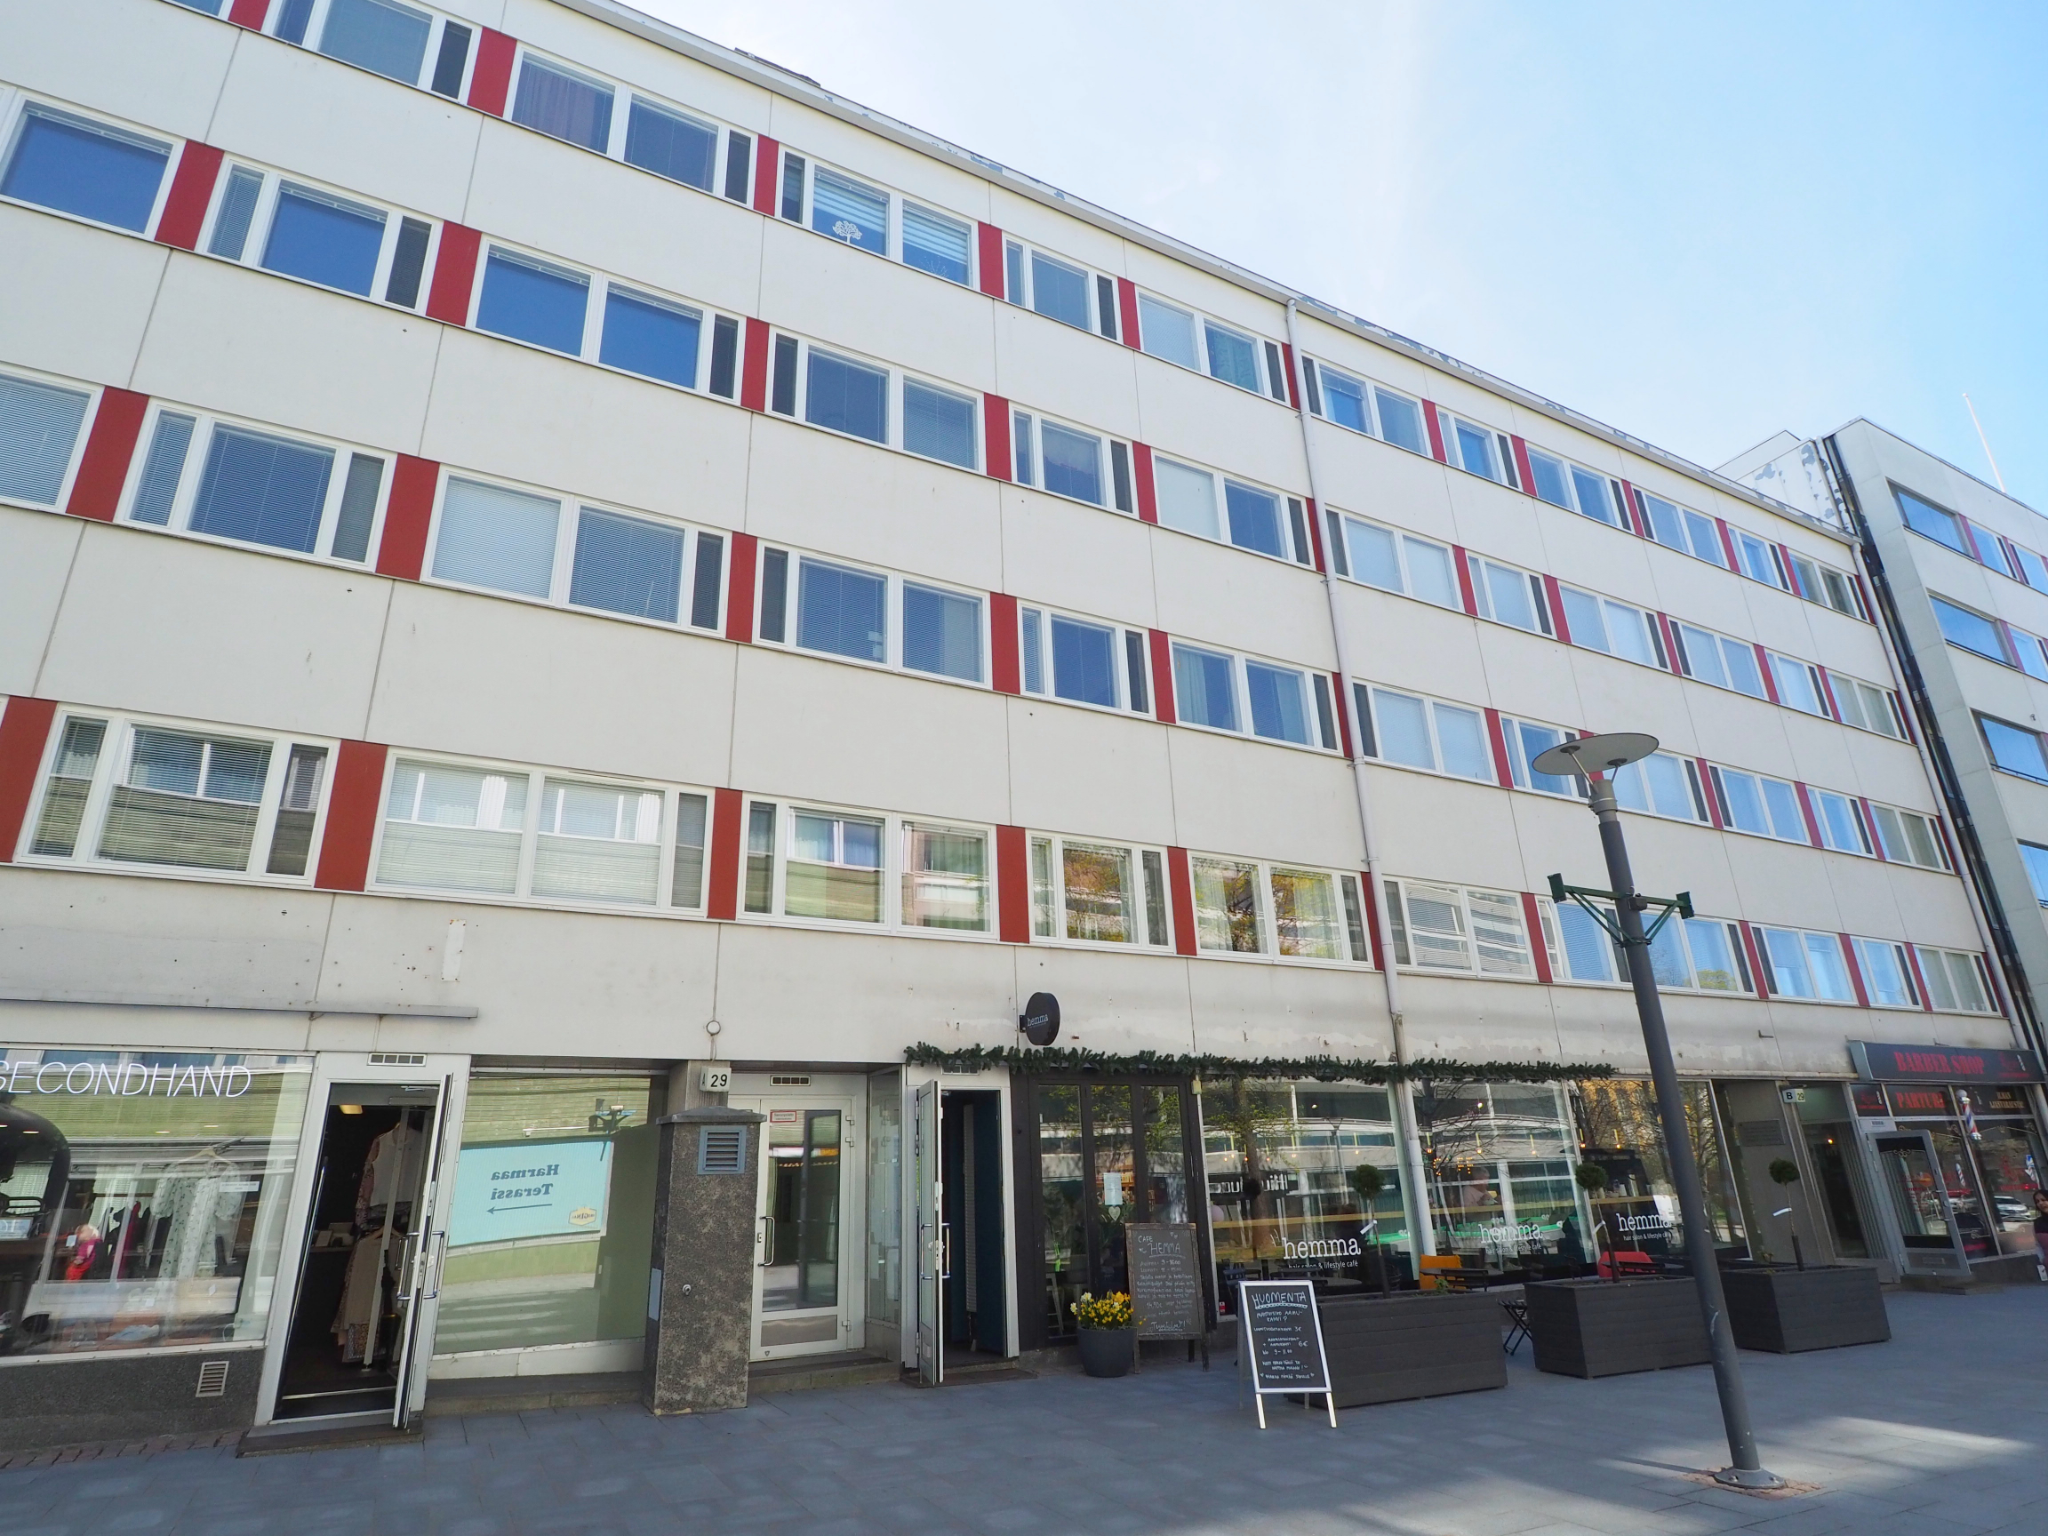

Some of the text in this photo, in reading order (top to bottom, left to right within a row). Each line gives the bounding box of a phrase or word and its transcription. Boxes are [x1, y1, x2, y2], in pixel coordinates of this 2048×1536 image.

[1893, 1051, 1951, 1073] BARBER
[1952, 1055, 1985, 1075] SHOP
[710, 1074, 728, 1088] 29
[1786, 1092, 1805, 1101] B 29
[1616, 1212, 1672, 1231] hemma
[1478, 1224, 1543, 1243] hemma
[1148, 1243, 1181, 1255] HEMMA
[1282, 1237, 1361, 1259] hemma
[1324, 1260, 1346, 1270] lifestyle
[1251, 1291, 1307, 1305] HUOMENTA
